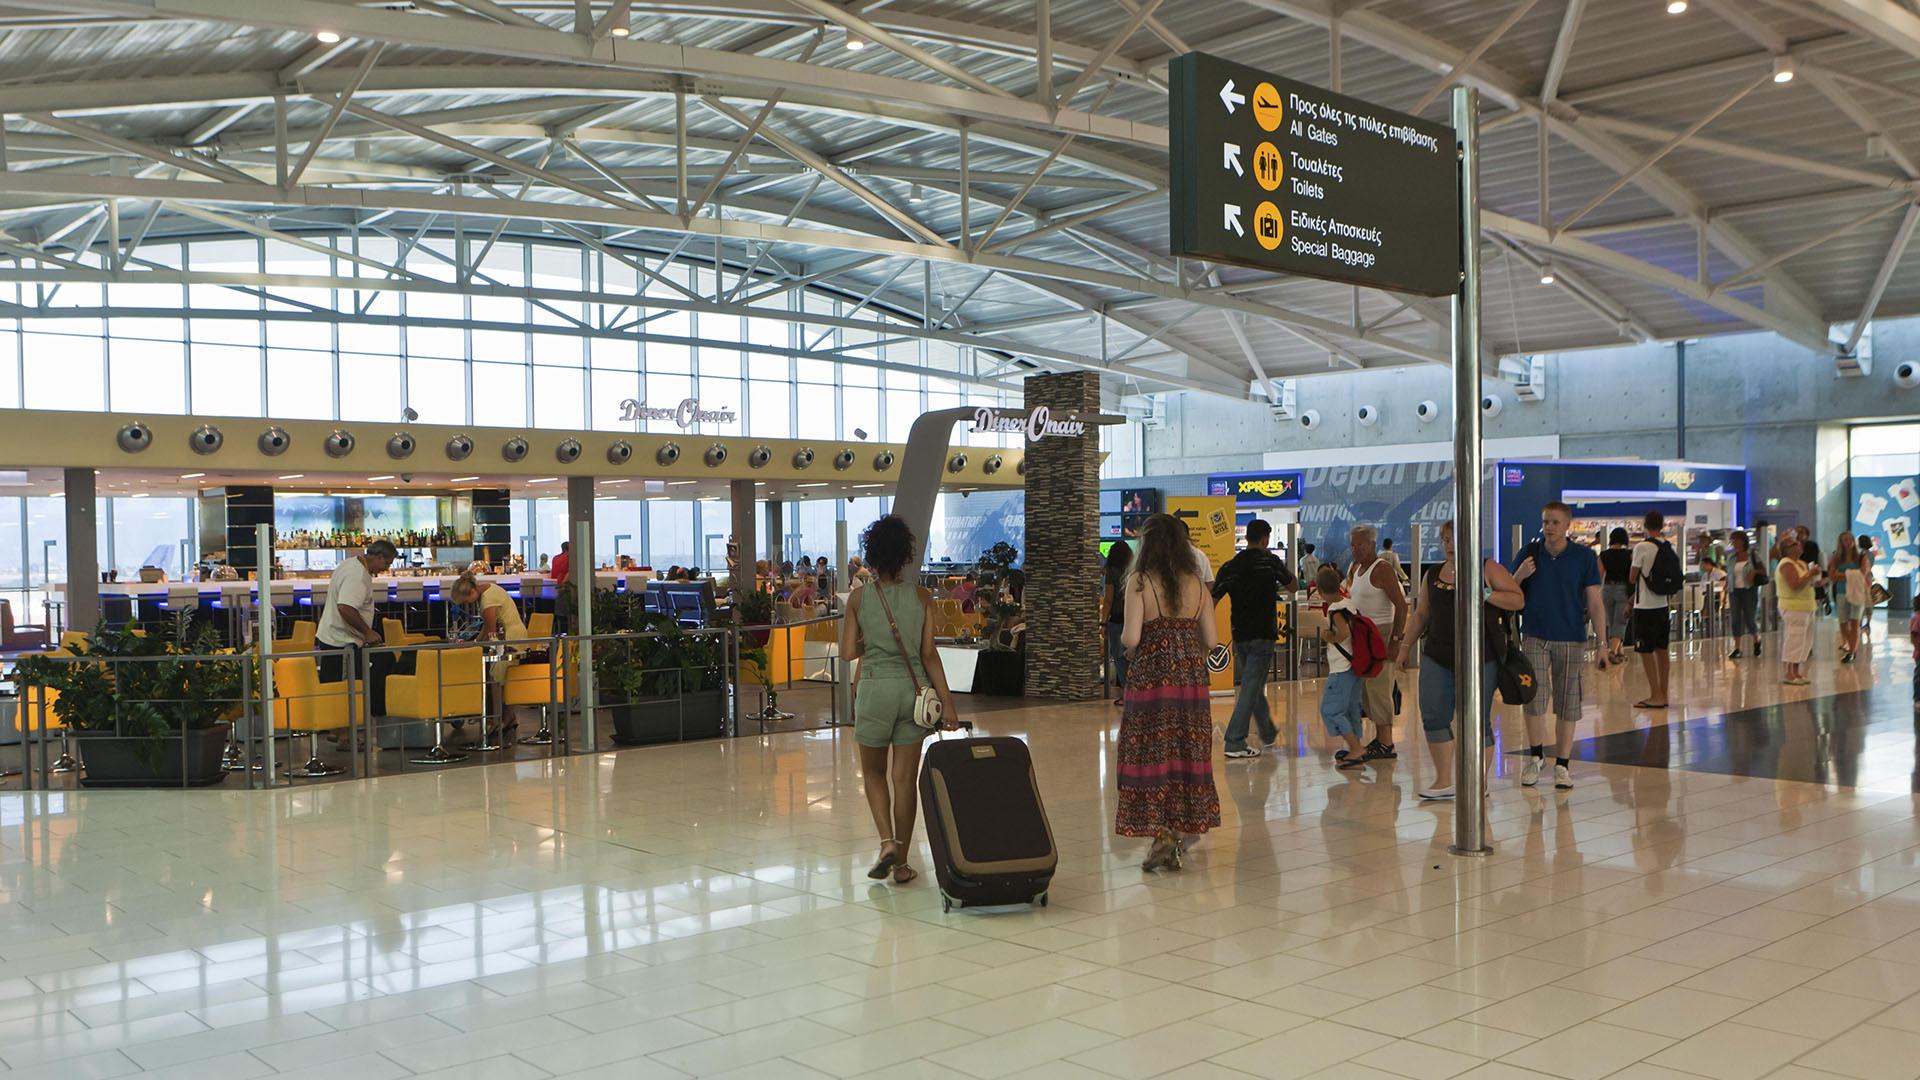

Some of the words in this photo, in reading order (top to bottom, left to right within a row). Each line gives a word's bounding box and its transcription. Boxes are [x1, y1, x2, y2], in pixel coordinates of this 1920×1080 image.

[1290, 93, 1317, 119] Προς
[1320, 102, 1342, 126] όλες
[1344, 112, 1357, 130] τις
[1359, 116, 1387, 139] πύλες
[1389, 126, 1438, 153] επιβίβασης
[1290, 120, 1302, 137] All
[1307, 124, 1338, 146] Gates
[1291, 151, 1343, 182] Τουαλέτες
[1291, 177, 1324, 199] Toilets
[1291, 210, 1327, 236] Ειδικές
[1328, 218, 1382, 247] Αποσκευές
[1291, 236, 1328, 256] Special
[1331, 243, 1375, 268] Baggage
